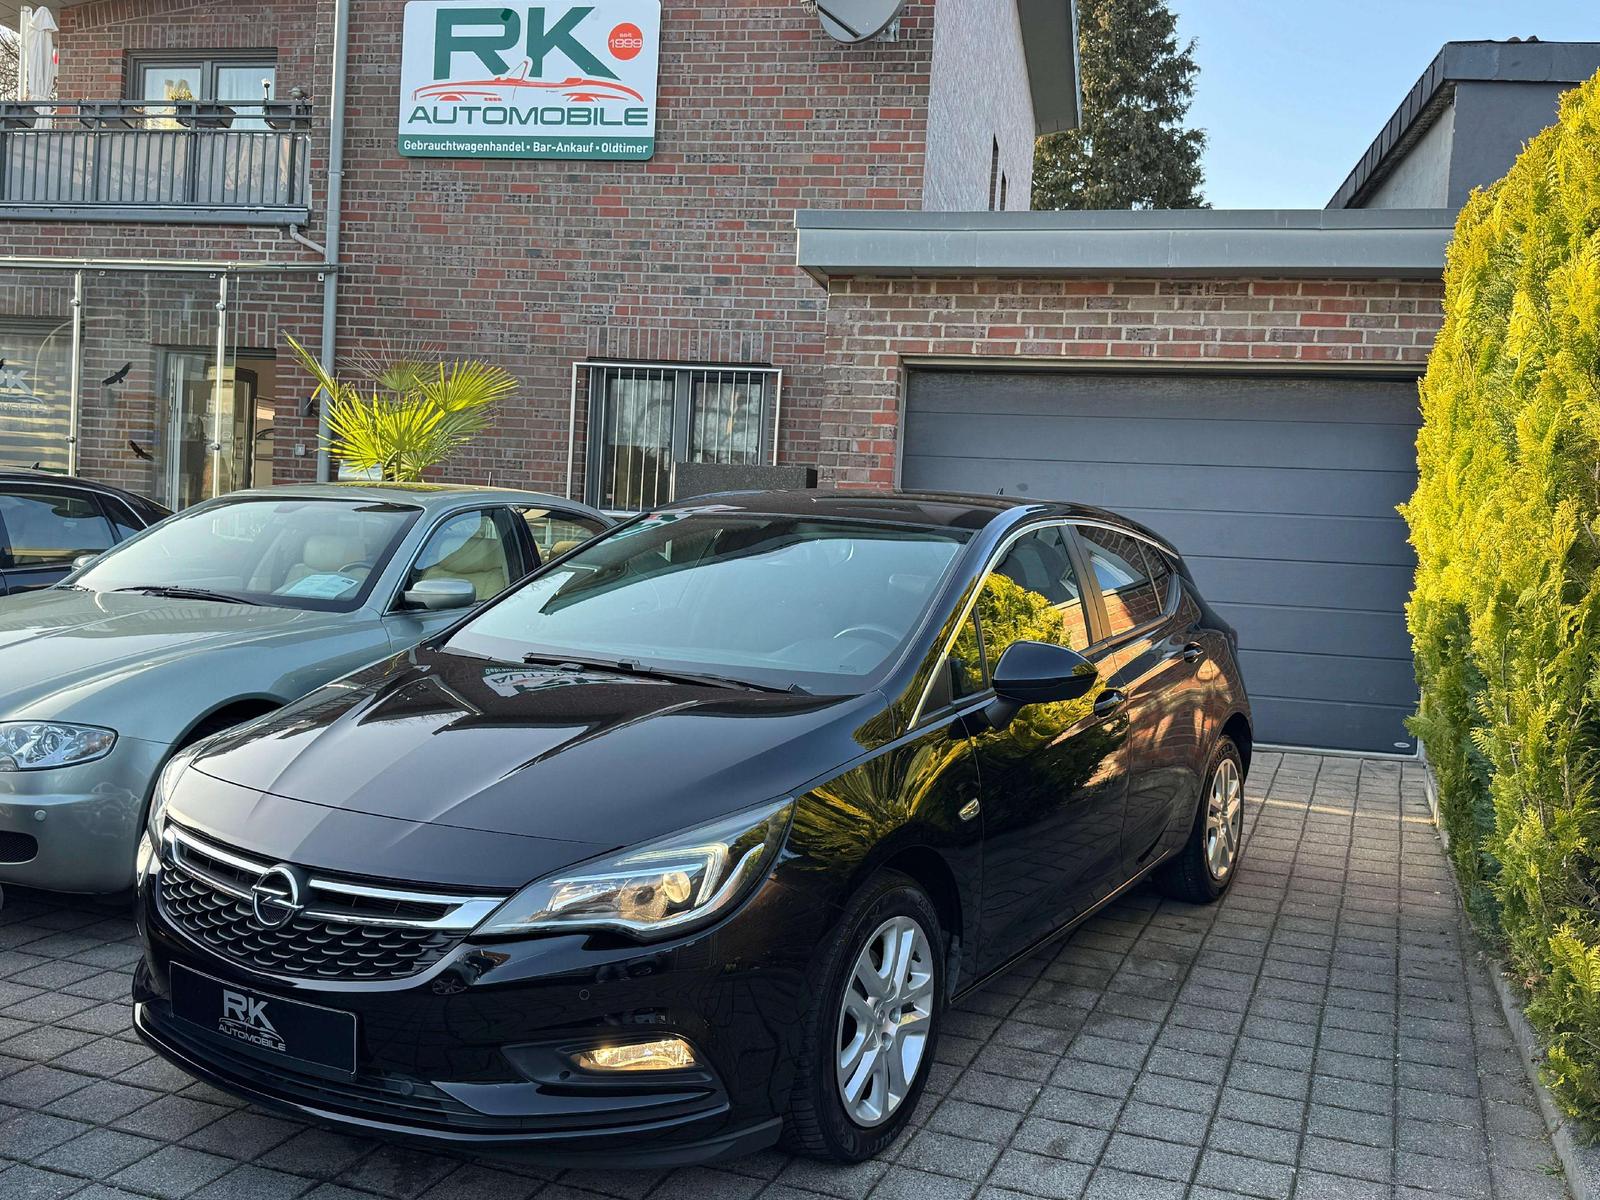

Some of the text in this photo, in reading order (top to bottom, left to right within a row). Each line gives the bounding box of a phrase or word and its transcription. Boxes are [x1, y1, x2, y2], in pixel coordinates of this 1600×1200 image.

[433, 6, 622, 81] RK
[609, 38, 643, 49] 1999
[407, 106, 649, 126] AUTOMOBILE
[403, 139, 649, 154] Gebrauchtwagenhandel Bar-Ankauf Oldtimer
[223, 989, 278, 1033] RK
[219, 1023, 287, 1052] AUTOMOBILE
